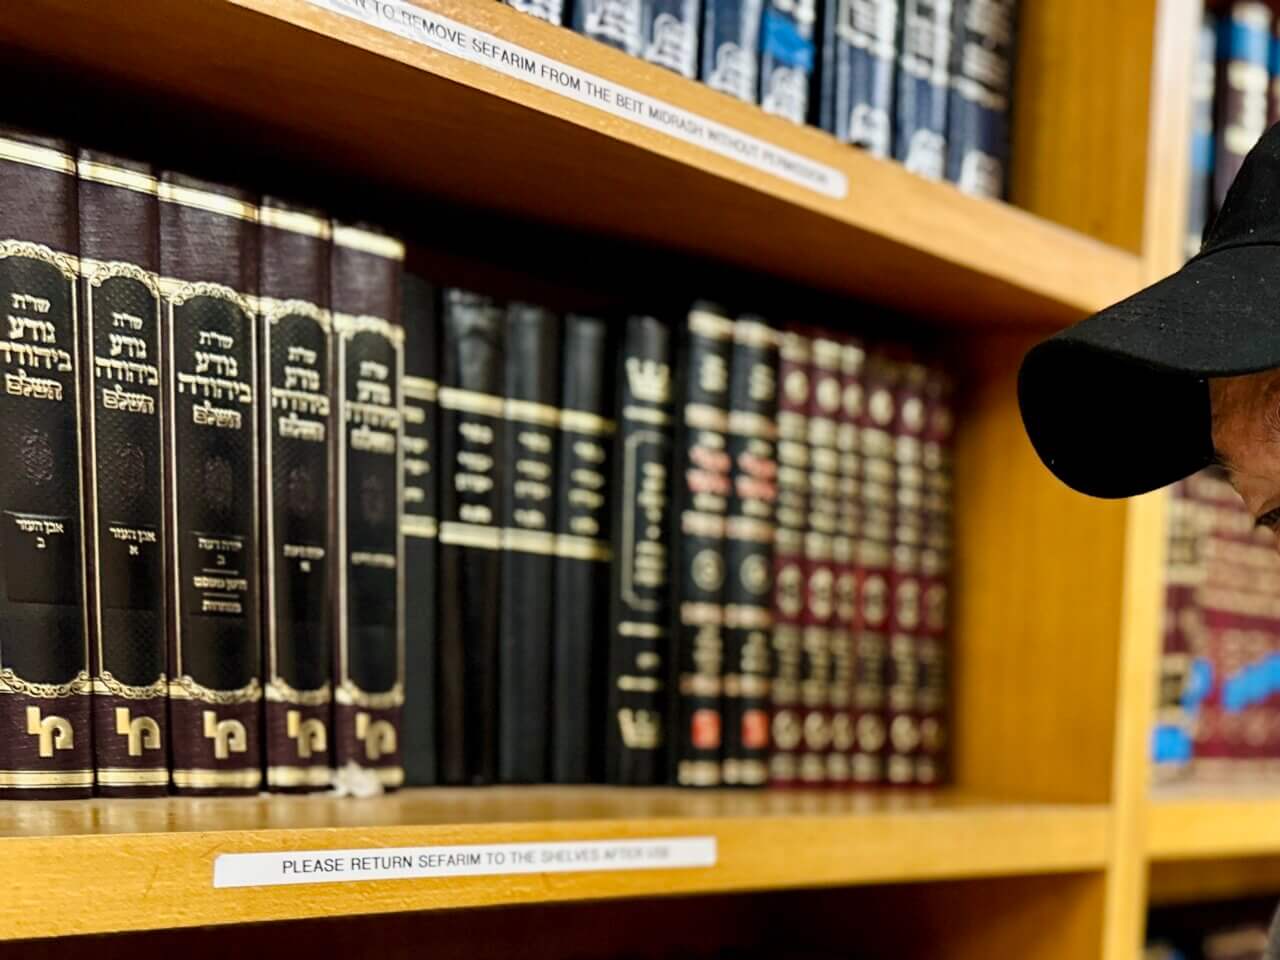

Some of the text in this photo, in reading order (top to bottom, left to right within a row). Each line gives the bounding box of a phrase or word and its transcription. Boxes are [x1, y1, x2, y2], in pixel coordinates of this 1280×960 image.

[373, 0, 395, 20] TO
[401, 10, 467, 48] REMOVE
[472, 38, 536, 74] SEFARIM
[541, 64, 581, 91] FROM
[586, 82, 612, 103] THE
[616, 93, 643, 113] BEIT
[649, 105, 704, 137] MIDRASH
[8, 314, 56, 343] נודע
[109, 333, 147, 359] נודע
[95, 356, 159, 386] ביהודה
[195, 351, 238, 377] נודע
[5, 368, 63, 401] השלם
[102, 383, 154, 414] השלם
[177, 372, 251, 403] ביהודה
[282, 858, 344, 874] PLEASE
[351, 856, 412, 871] RETURN
[418, 853, 481, 868] SEFARIM
[486, 852, 505, 865] TO
[511, 850, 537, 865] THE
[540, 848, 599, 864] SHELVES
